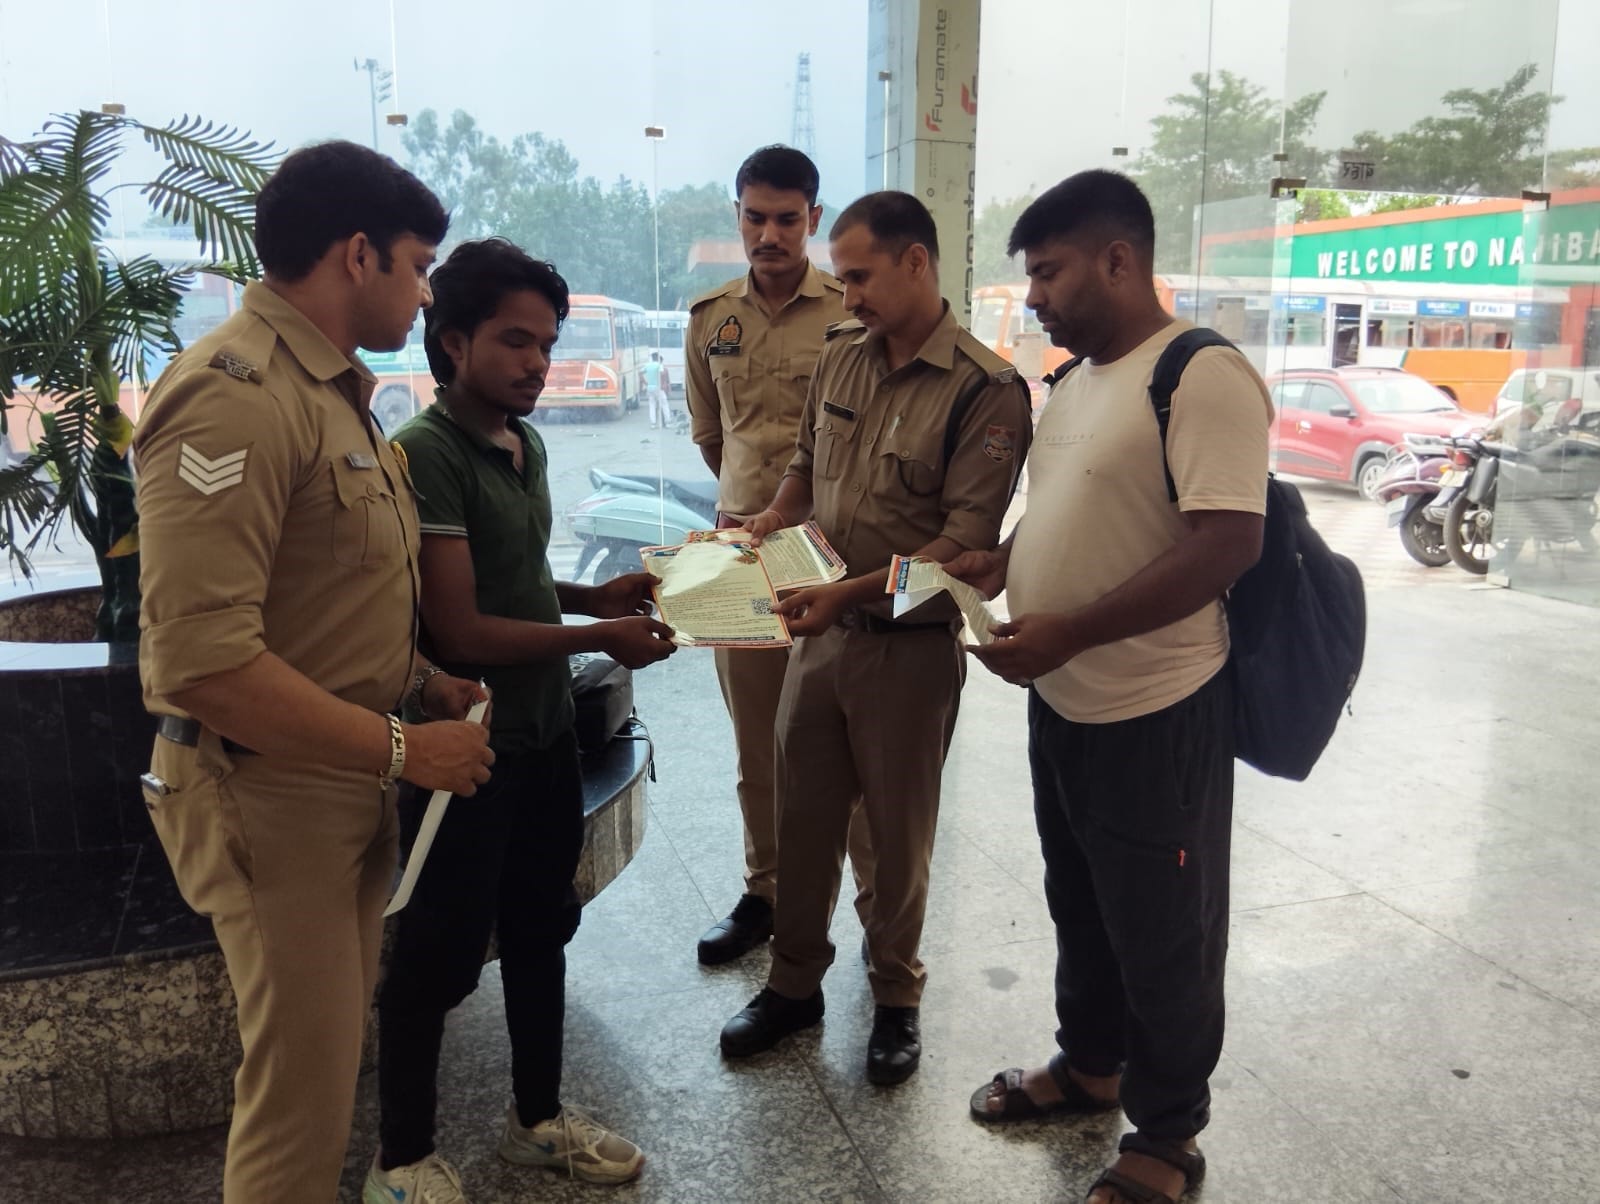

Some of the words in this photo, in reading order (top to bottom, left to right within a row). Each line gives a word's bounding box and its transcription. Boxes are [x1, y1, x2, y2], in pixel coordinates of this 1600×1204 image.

[931, 9, 947, 123] Furamate
[1317, 243, 1434, 277] WELCOME
[1443, 239, 1479, 270] TO
